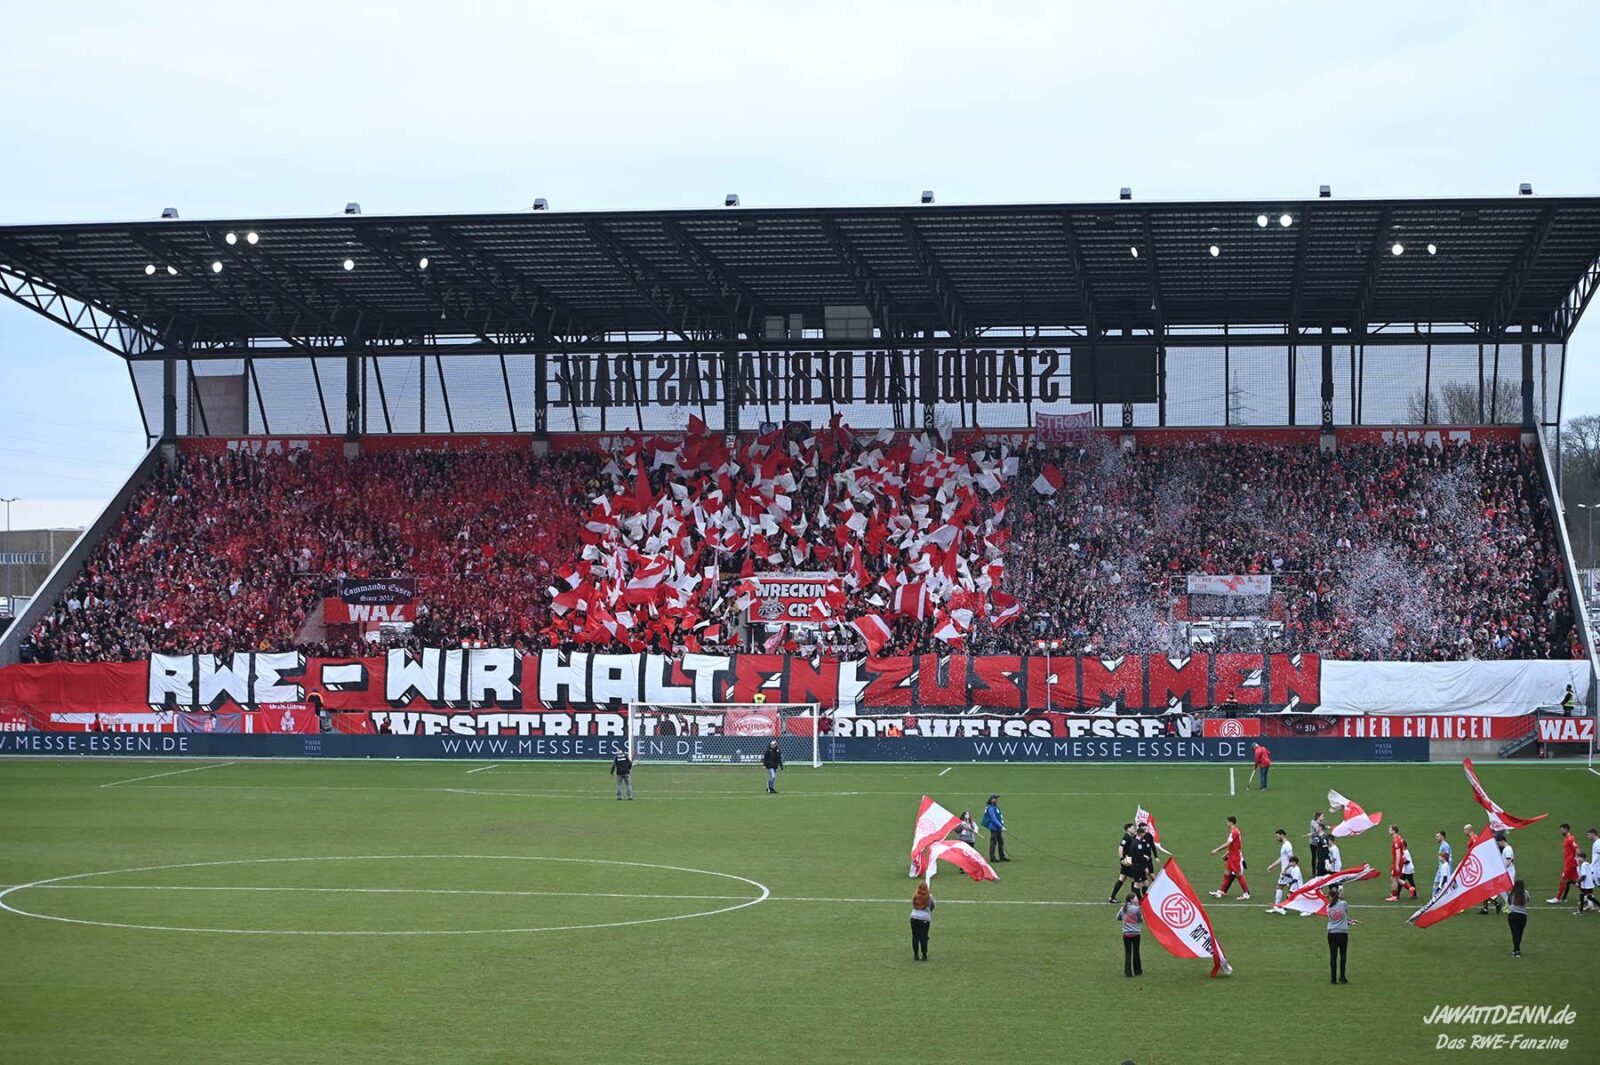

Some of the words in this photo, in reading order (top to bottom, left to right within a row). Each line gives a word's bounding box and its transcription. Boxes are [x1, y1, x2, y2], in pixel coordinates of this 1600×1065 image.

[925, 414, 933, 426] 2
[1124, 413, 1131, 424] 3
[1324, 411, 1331, 422] 3
[343, 583, 386, 596] Commando
[388, 584, 412, 597] Essen
[347, 604, 405, 622] WAZ
[149, 651, 302, 707] RWE
[387, 648, 521, 706] WIR
[539, 650, 840, 708] HALTEN
[862, 653, 1321, 710] ZUSAMMEN
[834, 716, 1051, 738] ROT-WEISS
[1403, 717, 1492, 739] CHANCEN
[1539, 719, 1594, 741] WAZ
[442, 738, 704, 756] WWW.MESSE-ESSEN.DE
[974, 741, 1246, 757] WWW.MESSE-ESSEN.DE
